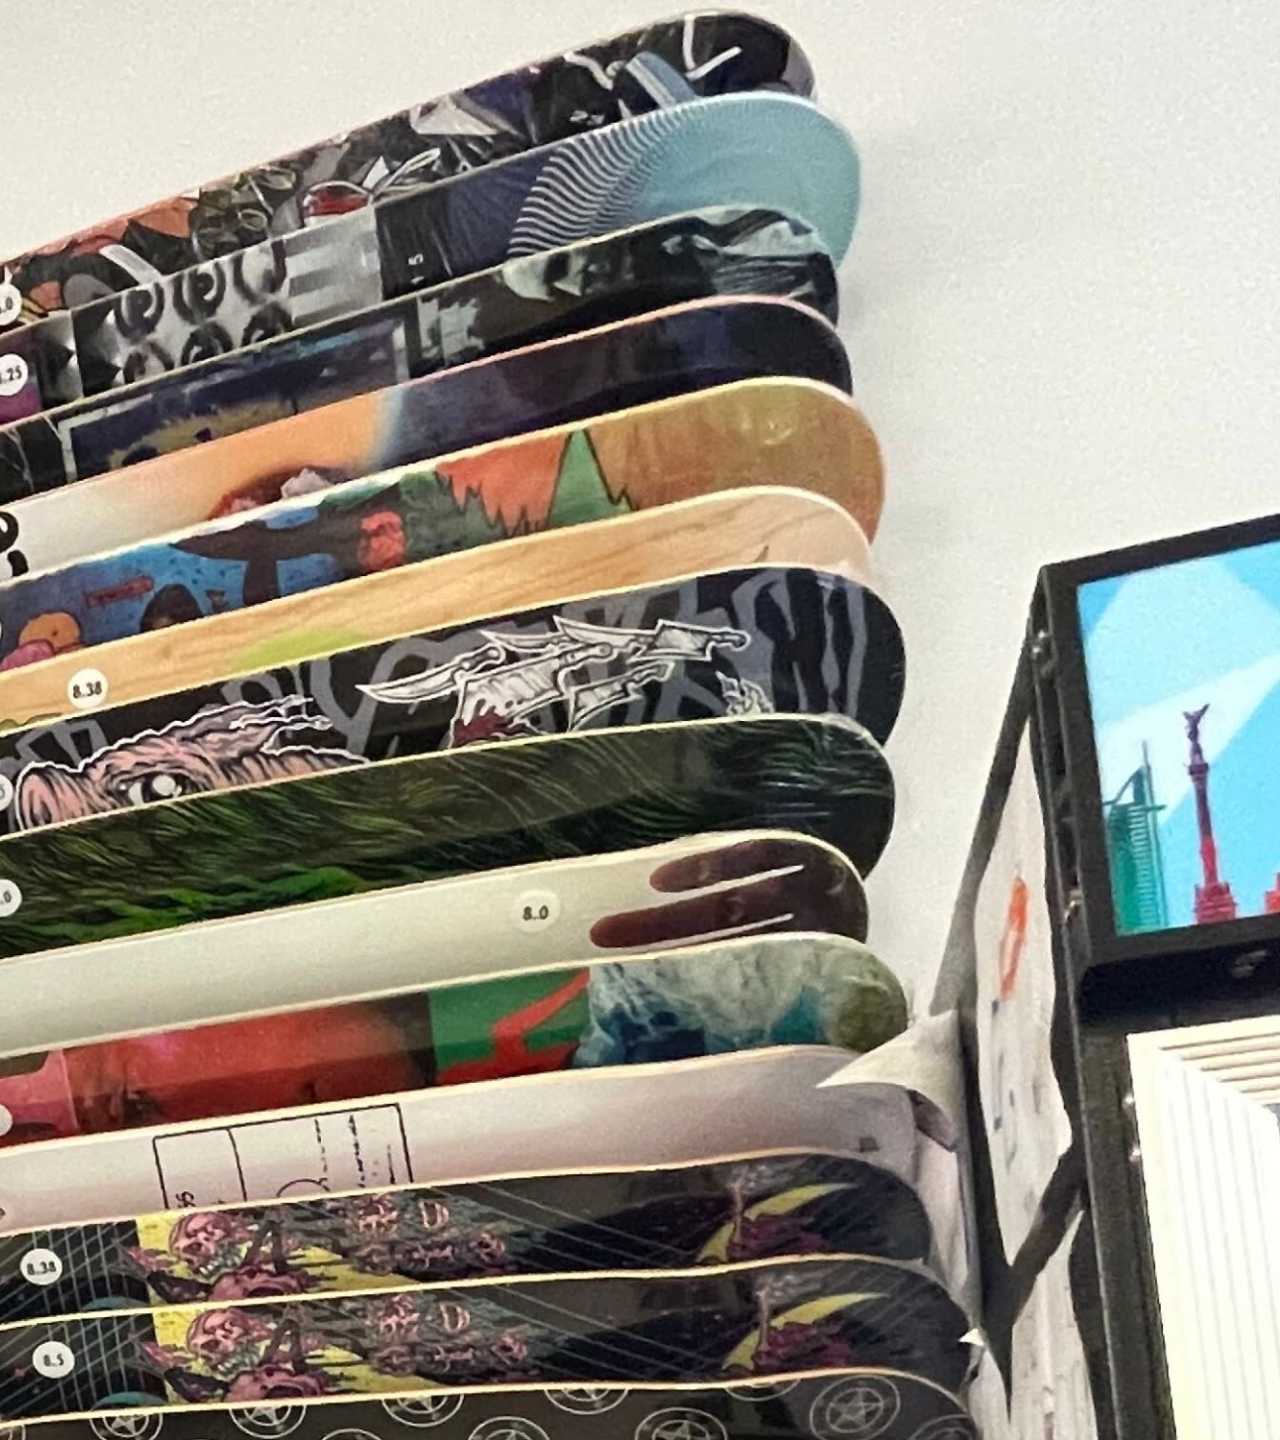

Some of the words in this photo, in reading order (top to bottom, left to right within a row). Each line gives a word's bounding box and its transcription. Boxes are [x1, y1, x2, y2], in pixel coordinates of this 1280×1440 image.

[72, 680, 103, 699] 8.38
[522, 904, 550, 921] 8.0
[42, 1352, 65, 1367] 8.5
